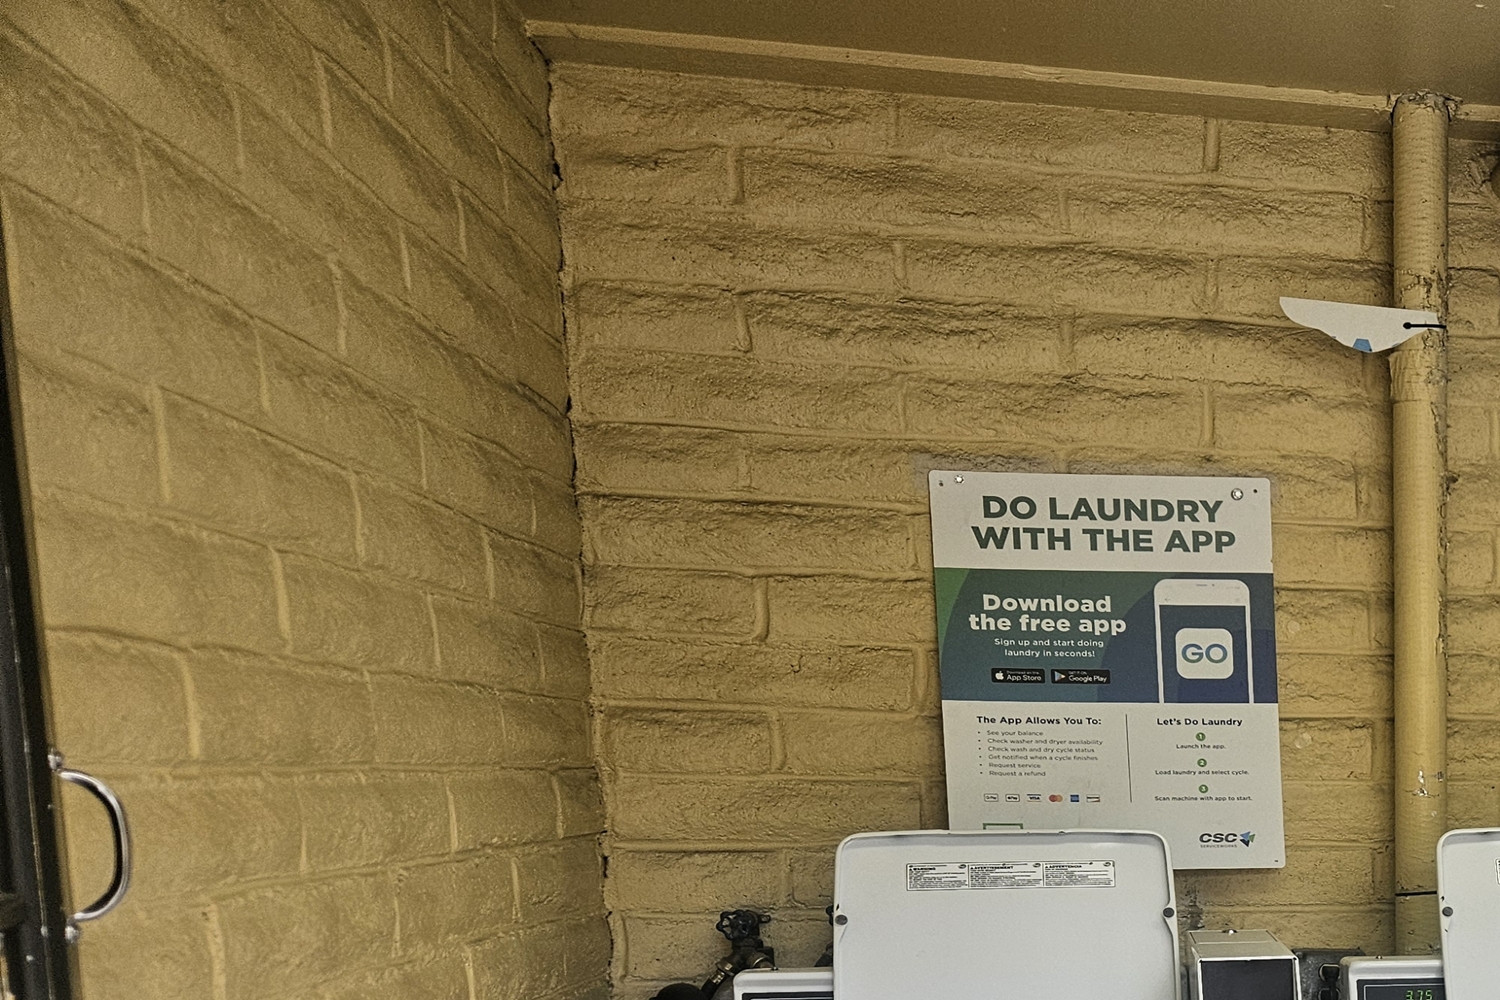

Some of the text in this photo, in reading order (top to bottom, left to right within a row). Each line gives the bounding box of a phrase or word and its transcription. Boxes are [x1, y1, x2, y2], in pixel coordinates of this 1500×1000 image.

[982, 495, 1223, 523] DO LAUNDRY
[971, 526, 1236, 553] WITH THE APP
[983, 594, 1112, 613] Download
[969, 613, 1127, 636] the free app
[994, 638, 1104, 648] Sign up and start doing
[1004, 649, 1096, 658] laundry in seconds!
[1181, 643, 1228, 664] GO
[1006, 674, 1022, 682] App
[1068, 675, 1107, 683] Google Play
[977, 716, 1102, 725] The App Allows You To:
[1156, 718, 1242, 727] Let's Do Laundry
[1199, 833, 1238, 843] CSC
